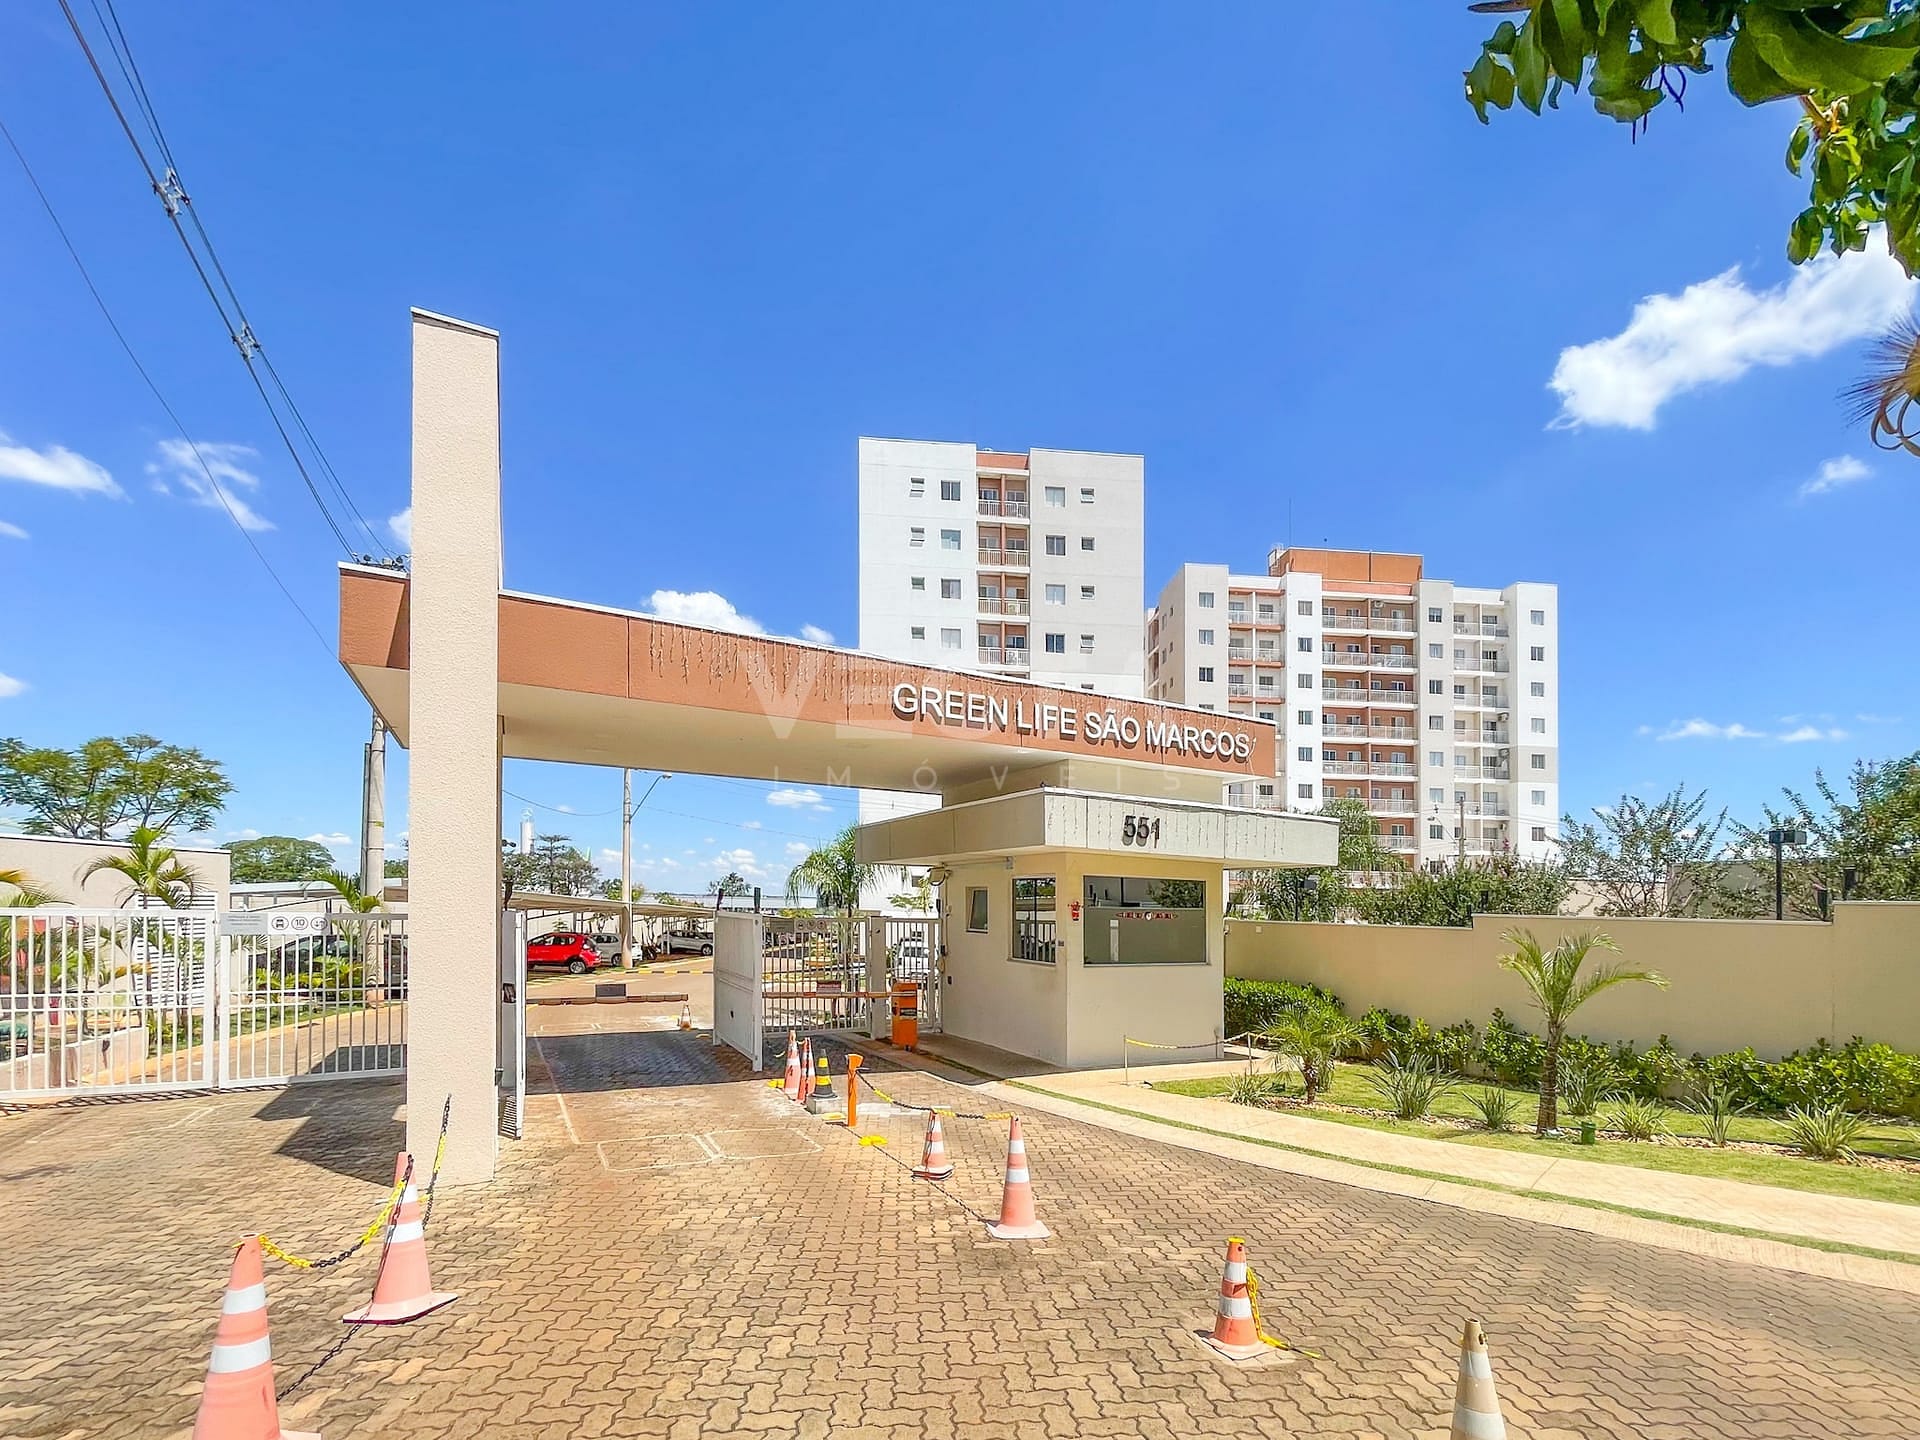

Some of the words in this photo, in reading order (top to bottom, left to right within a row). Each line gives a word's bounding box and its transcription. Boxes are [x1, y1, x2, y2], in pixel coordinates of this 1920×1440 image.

[893, 682, 1008, 727] GREEN
[1016, 699, 1077, 736] LIFE
[1085, 708, 1141, 743] SÃO
[1146, 720, 1250, 758] MARCOS
[1123, 815, 1160, 840] 551
